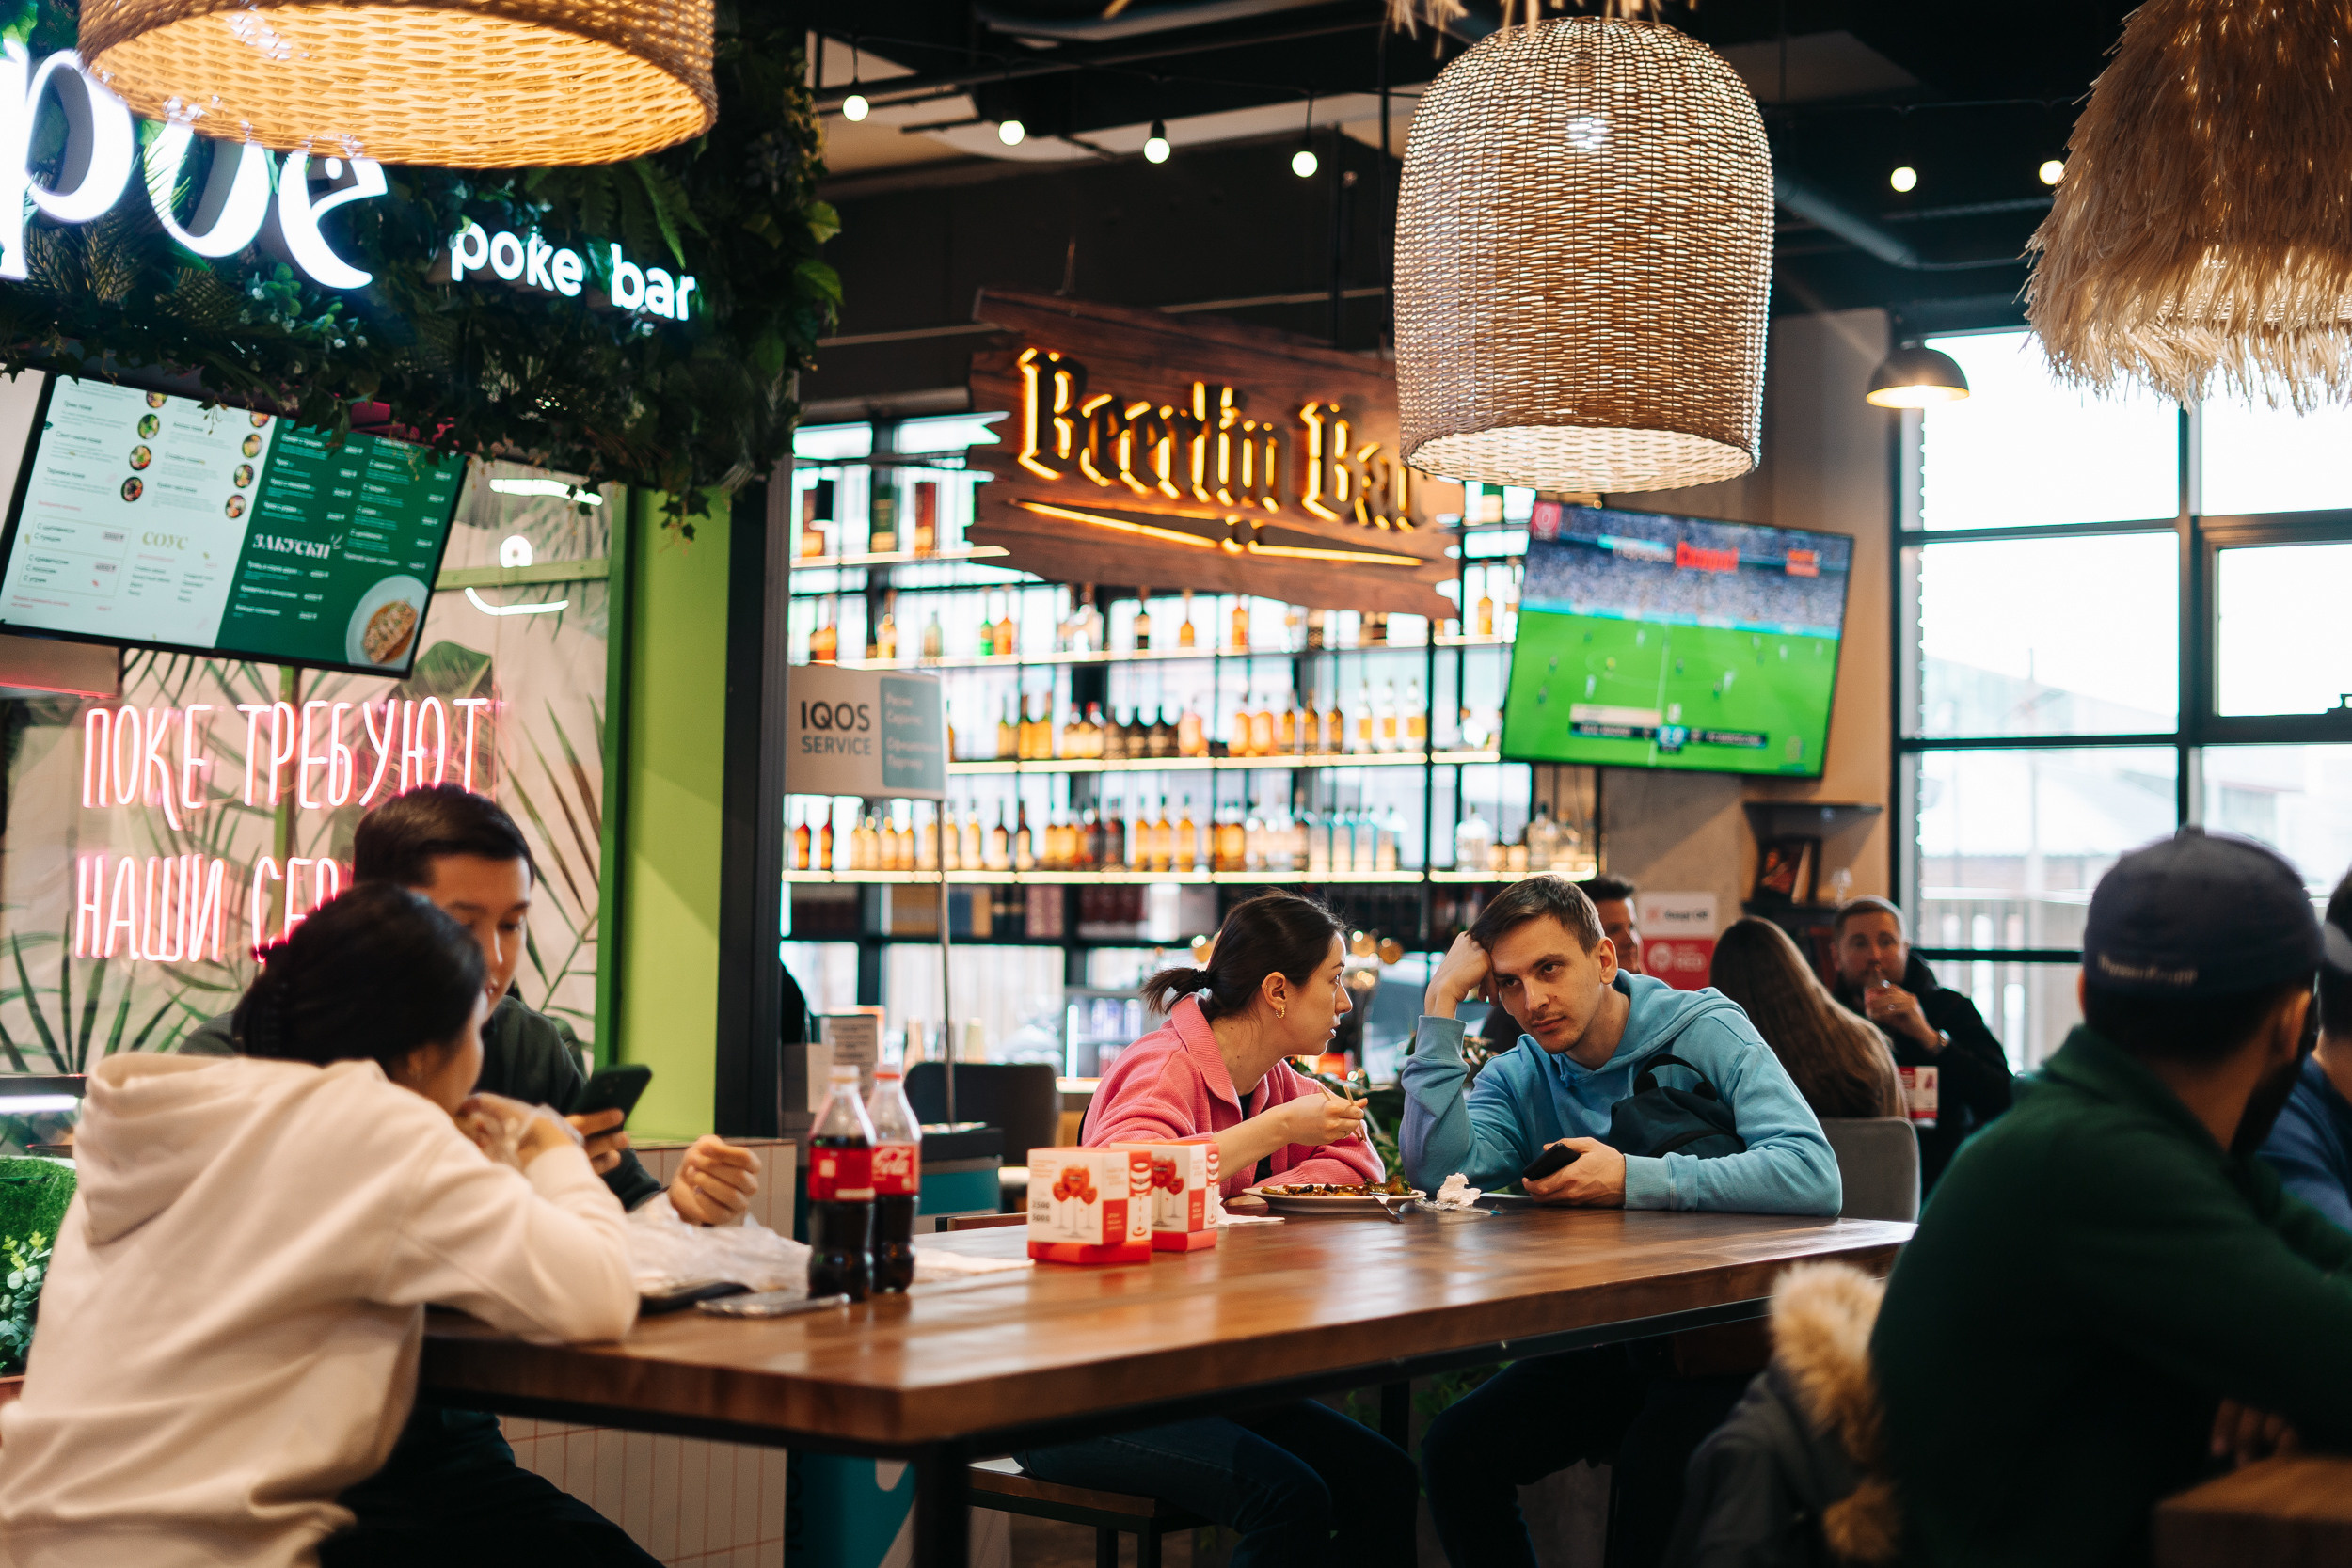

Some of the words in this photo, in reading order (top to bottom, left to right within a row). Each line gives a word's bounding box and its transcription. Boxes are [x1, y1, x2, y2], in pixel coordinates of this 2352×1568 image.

[451, 222, 584, 297] poke
[610, 242, 696, 321] bar
[142, 531, 189, 551] СОУС
[252, 532, 331, 560] ЗАКУСКИ
[801, 701, 871, 732] IQOS
[801, 735, 871, 755] SERVICE
[82, 704, 213, 831] ПОКЕ
[236, 697, 490, 809] ТРЕБУЮТ
[75, 854, 226, 962] НАШИ
